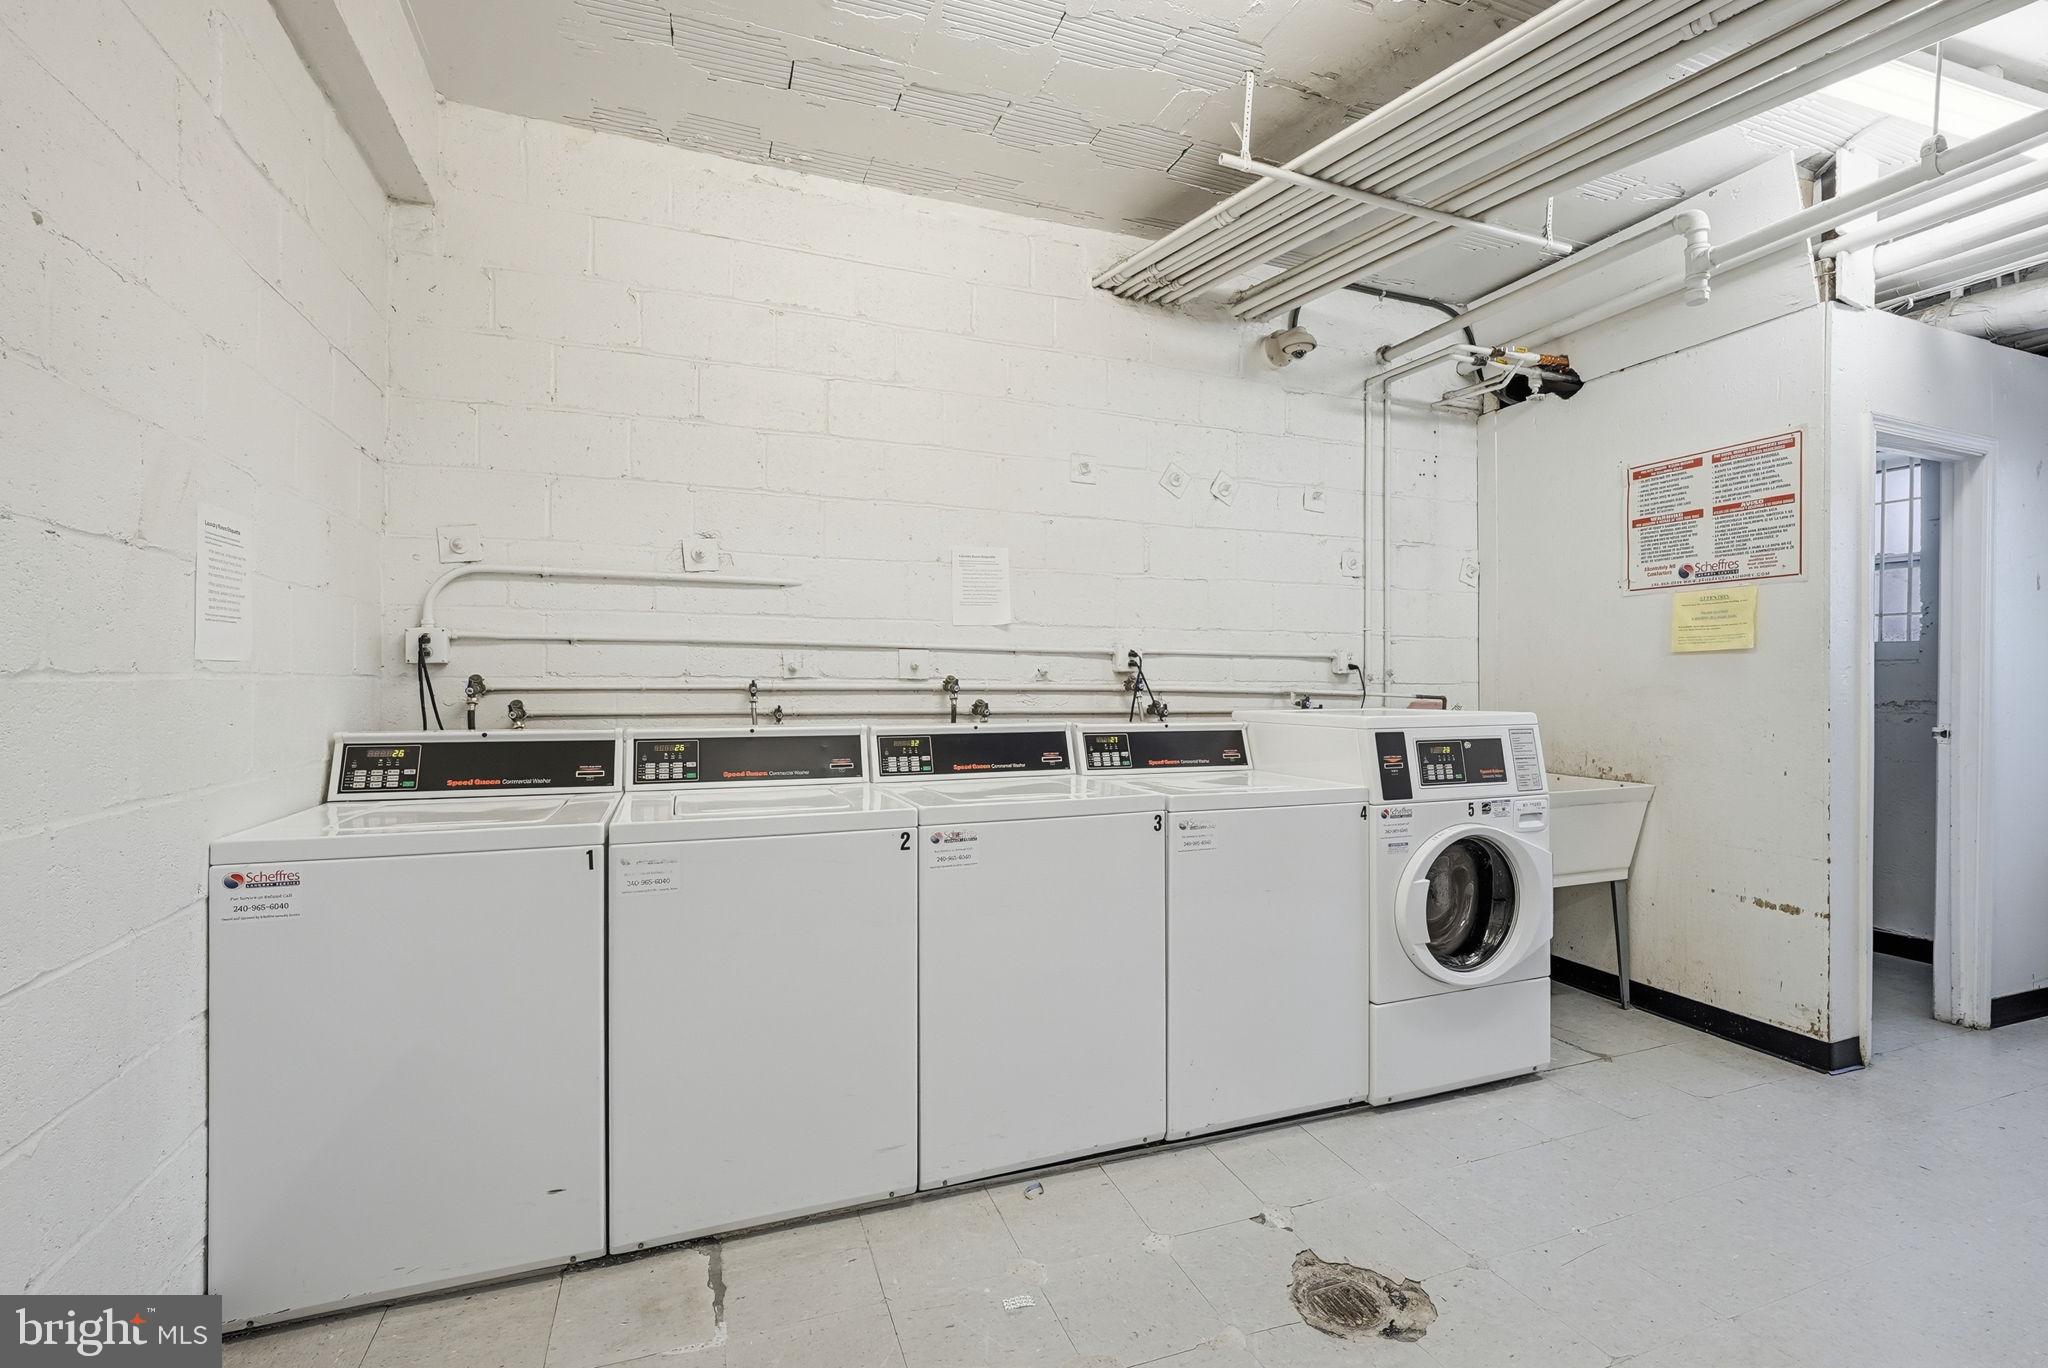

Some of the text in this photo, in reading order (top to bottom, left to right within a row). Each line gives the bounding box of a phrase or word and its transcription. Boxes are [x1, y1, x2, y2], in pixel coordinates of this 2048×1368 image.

[1695, 558, 1740, 573] Scheffres
[392, 750, 404, 758] 26
[1360, 806, 1368, 820] 4
[1468, 802, 1475, 817] 5
[1154, 814, 1162, 832] 3
[900, 832, 910, 850] 2
[586, 850, 594, 870] 1
[246, 870, 300, 884] Scheffres
[233, 902, 290, 912] 240-965-6040
